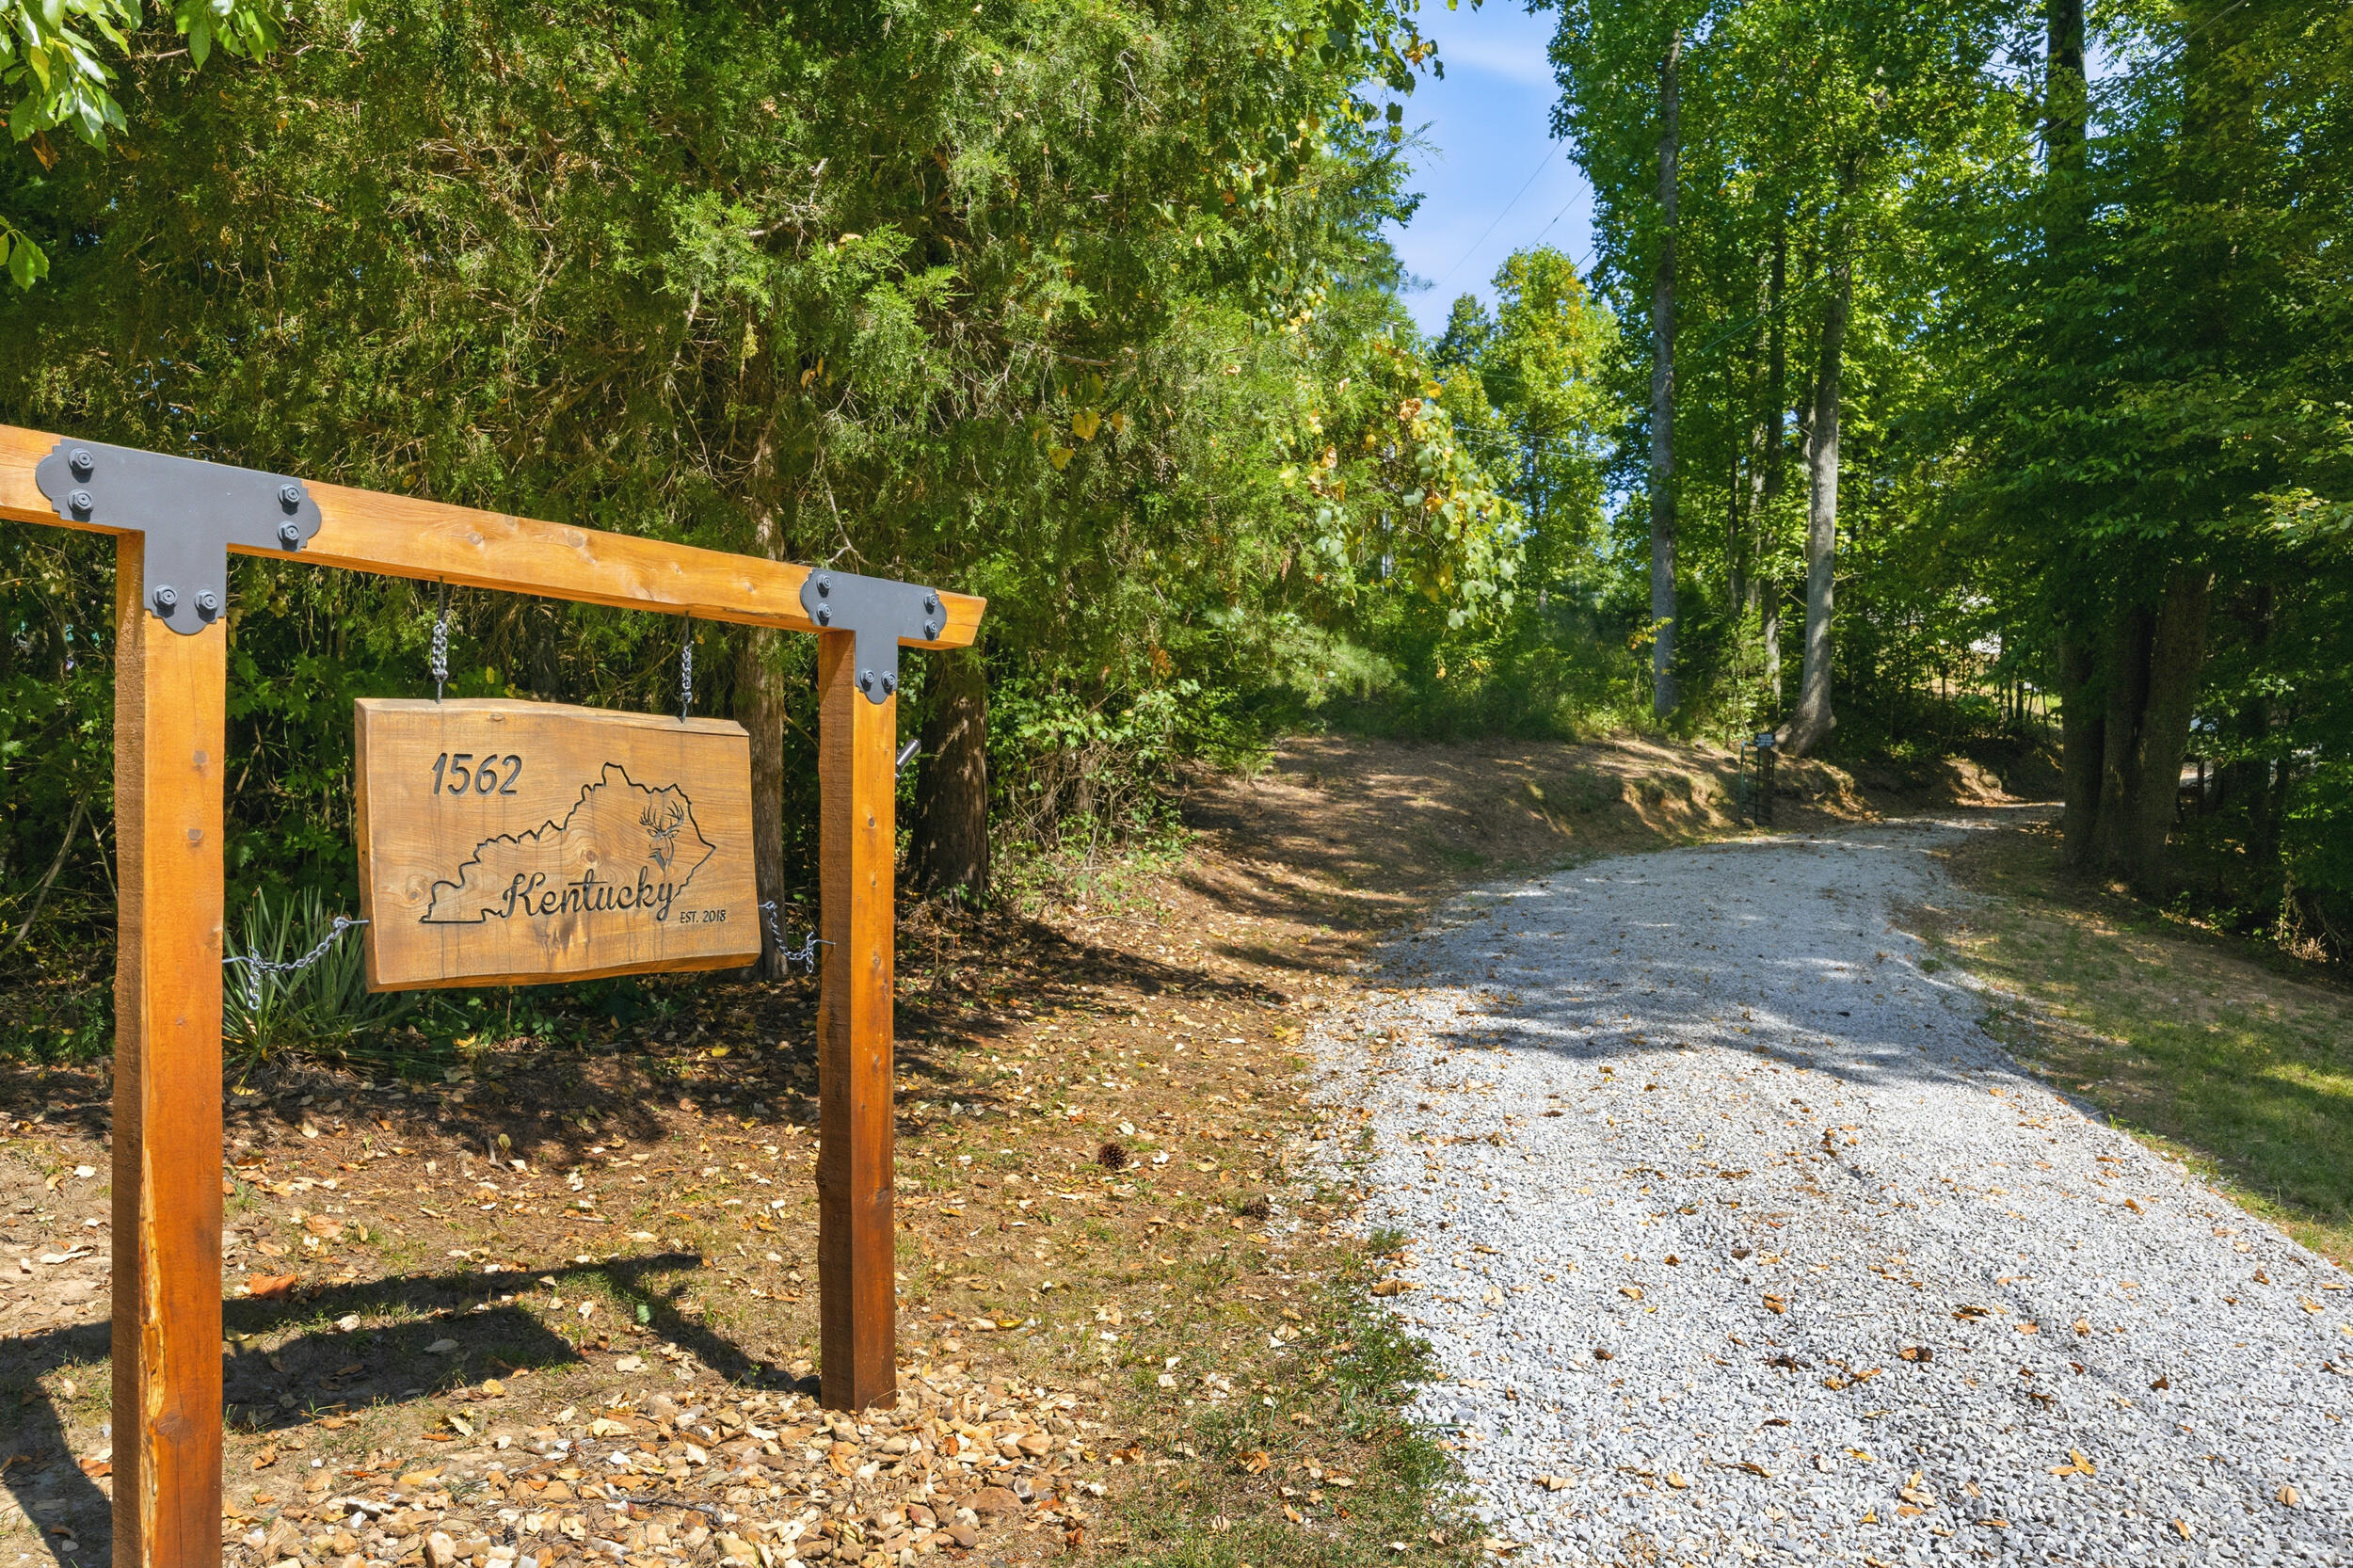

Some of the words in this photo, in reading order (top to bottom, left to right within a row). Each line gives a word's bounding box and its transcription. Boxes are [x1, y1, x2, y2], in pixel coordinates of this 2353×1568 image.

[431, 752, 522, 795] 1562
[501, 865, 674, 922] Kentucky
[680, 910, 698, 923] EST.
[702, 909, 727, 923] 2018
